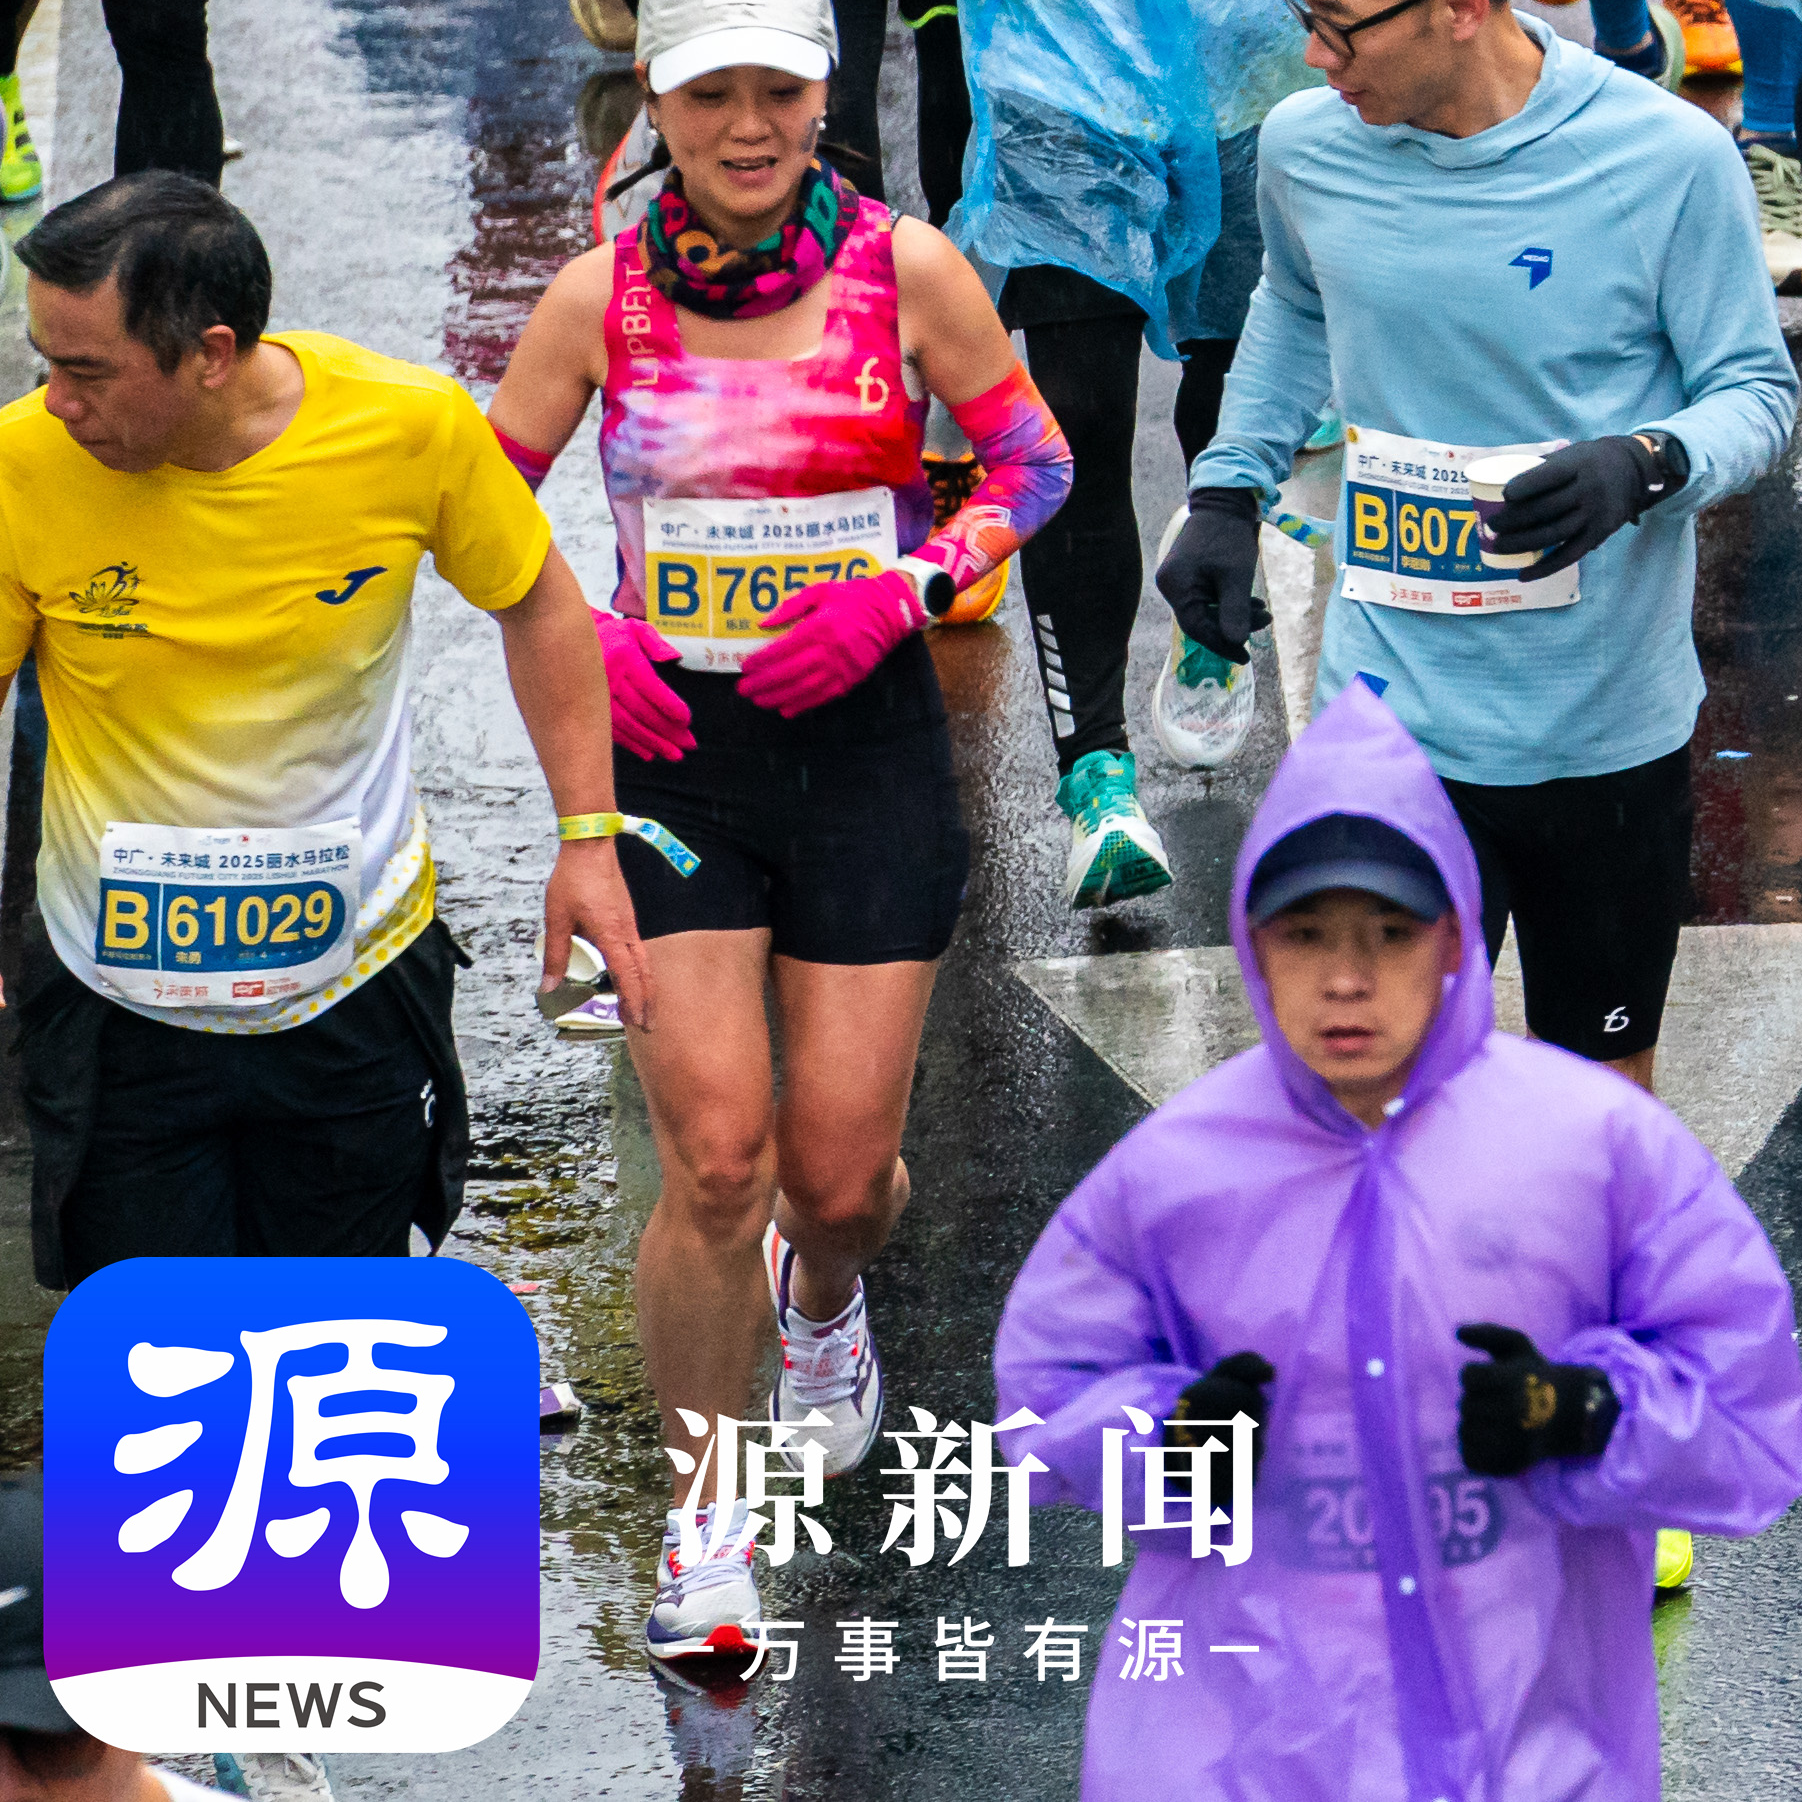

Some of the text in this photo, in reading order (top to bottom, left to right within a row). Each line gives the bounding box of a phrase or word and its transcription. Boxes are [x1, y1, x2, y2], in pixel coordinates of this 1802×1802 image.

[1432, 467, 1471, 484] 2025
[1354, 491, 1476, 557] B 607
[658, 561, 700, 617] B
[112, 843, 351, 870] 中广·未来城 2025丽水马拉松
[103, 889, 333, 949] B 61029
